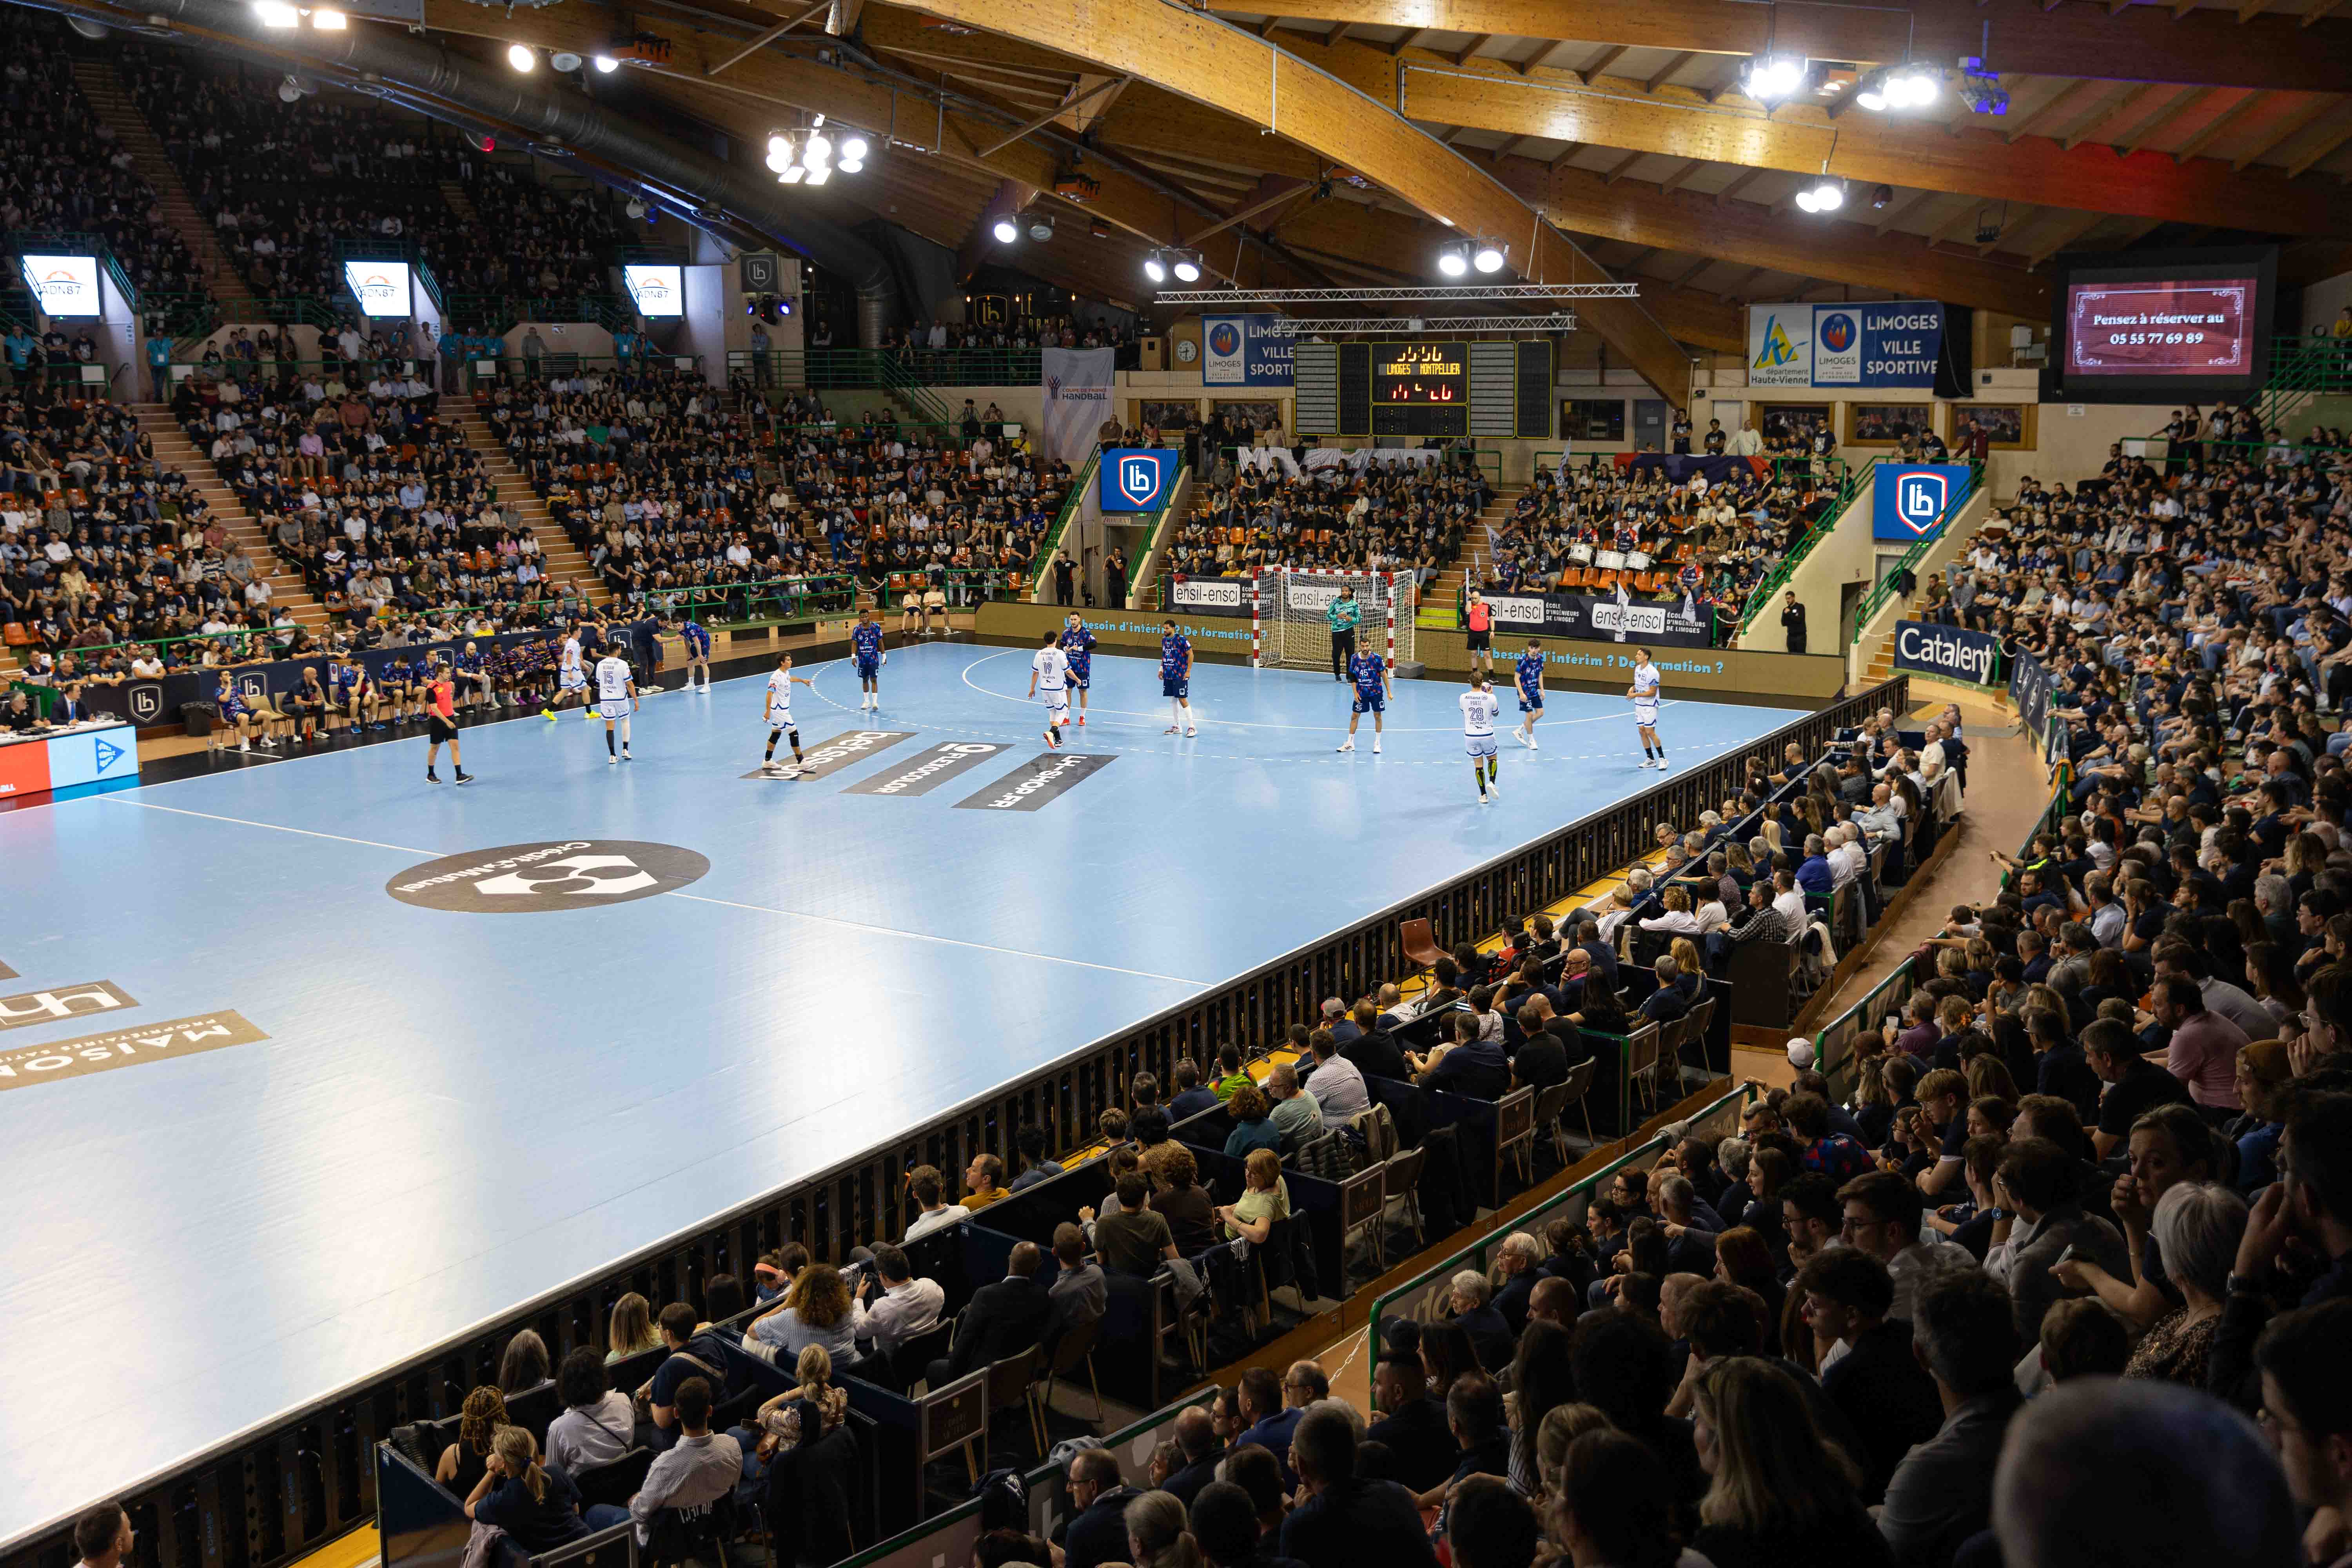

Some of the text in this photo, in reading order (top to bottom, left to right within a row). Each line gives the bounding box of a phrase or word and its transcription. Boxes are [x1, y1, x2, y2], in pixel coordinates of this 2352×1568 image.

[42, 286, 80, 294] ADN87
[1867, 315, 1938, 330] LIMOGES
[2094, 312, 2224, 325] Pensez à réserver au
[2110, 332, 2204, 344] 05 55 77 69 89
[1262, 347, 1294, 358] VILLE
[1882, 340, 1921, 354] VILLE
[1387, 363, 1460, 375] LIMOGES MONTPELLIER
[1867, 359, 1938, 374] SPORTIVE
[1751, 376, 1809, 384] Haute-Vienne
[1176, 585, 1238, 603] ensil-ensci
[1595, 610, 1662, 630] ens-ensci
[1082, 619, 1116, 631] besoin
[1184, 626, 1198, 637] De
[1044, 662, 1052, 674] 19
[1607, 655, 1614, 667] ?
[1619, 655, 1636, 668] De
[1716, 661, 1724, 673] ?
[603, 671, 613, 684] 15
[1468, 708, 1484, 721] 28
[873, 753, 969, 793] FLEXOCOLOR
[987, 755, 1088, 808] LH-SHOP.FR
[394, 842, 591, 892] Crédit Mutuel
